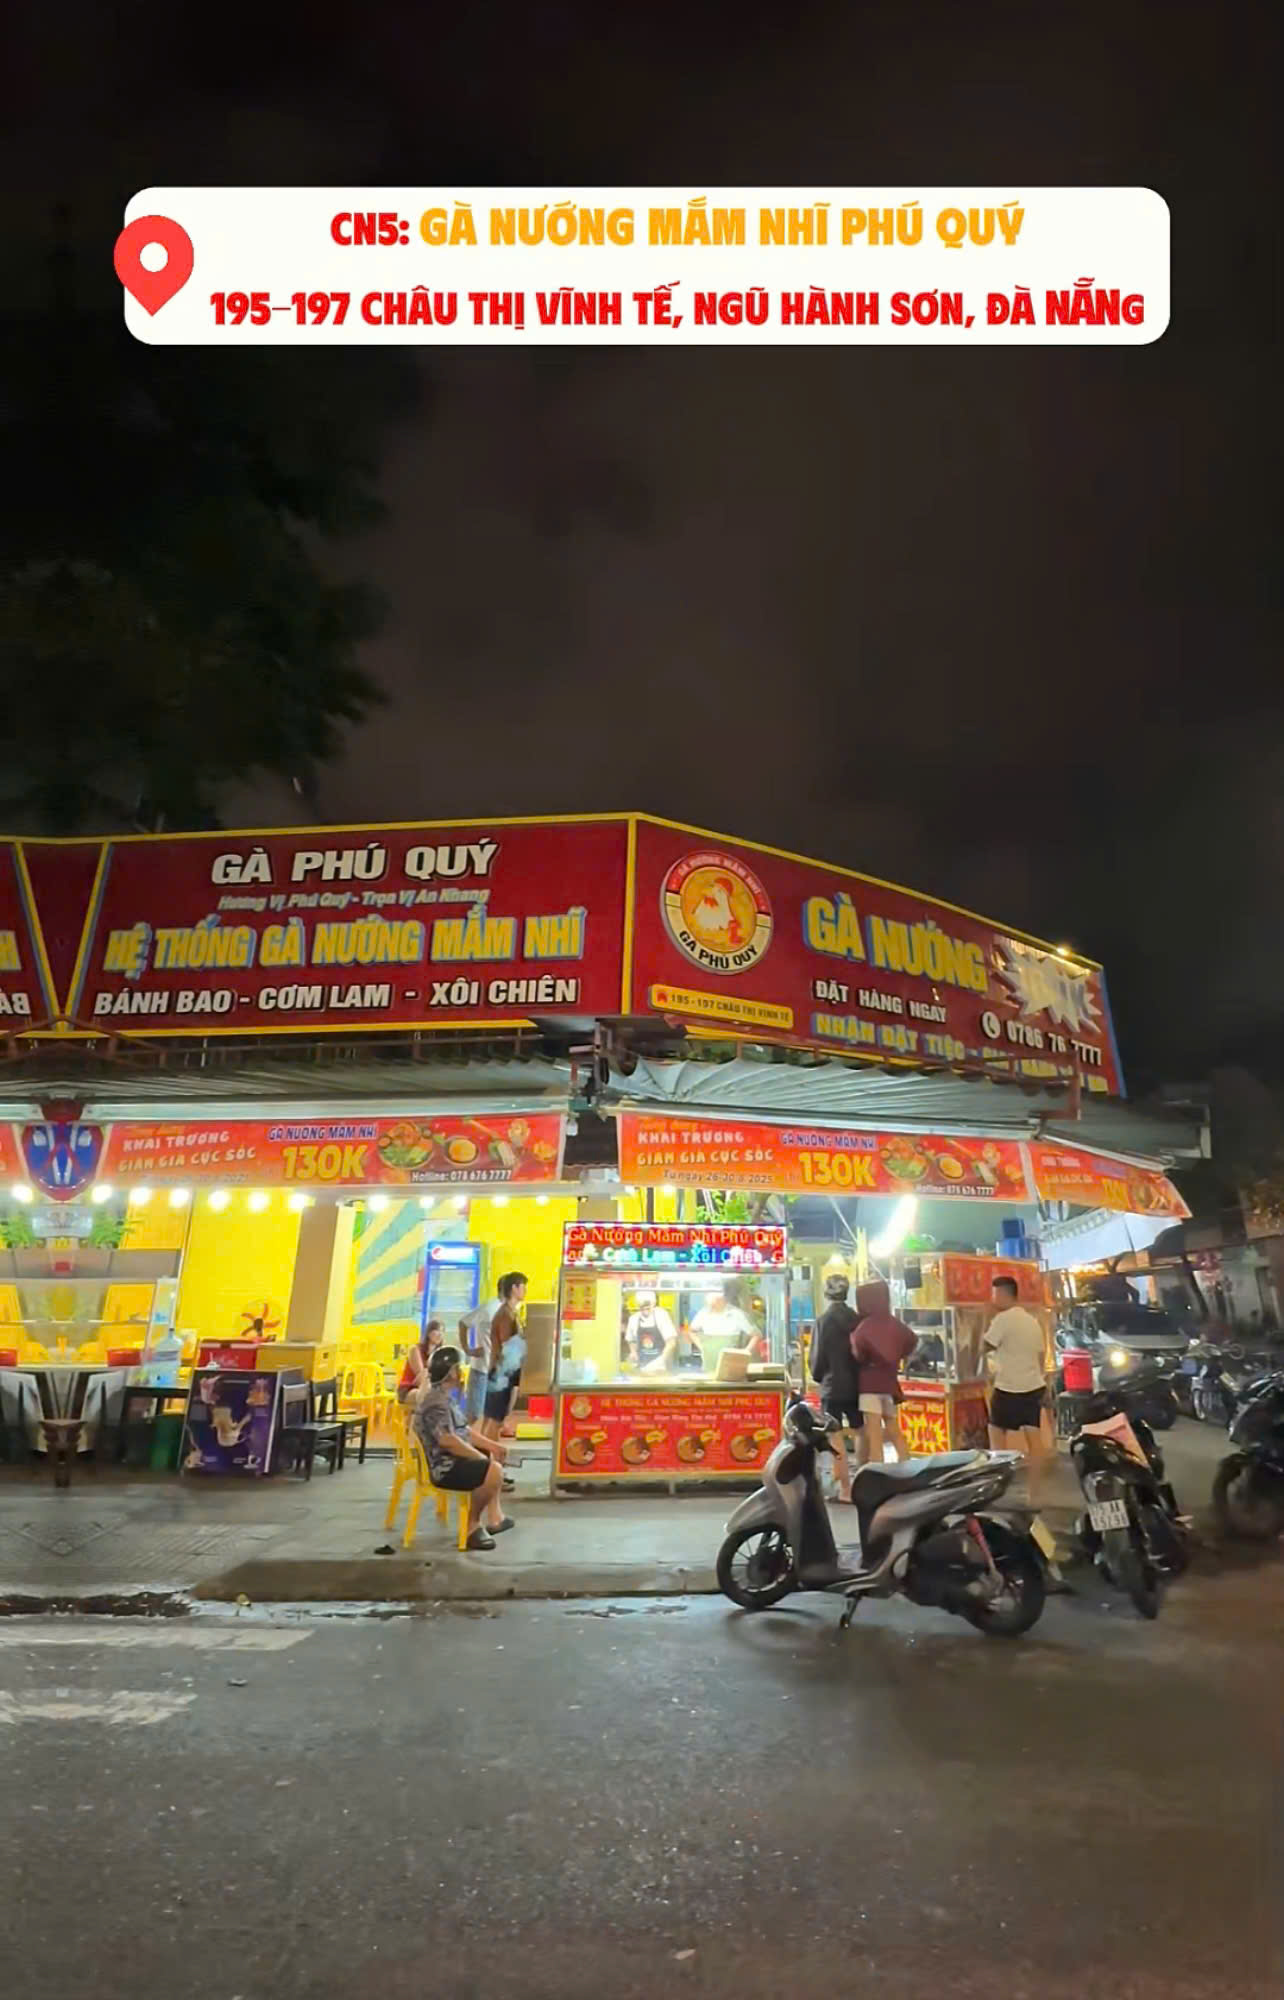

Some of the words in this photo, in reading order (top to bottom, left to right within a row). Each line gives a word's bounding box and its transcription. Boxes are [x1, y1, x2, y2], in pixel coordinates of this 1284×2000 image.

[211, 848, 272, 884] GÀ
[291, 843, 386, 882] PHÚ
[404, 838, 497, 880] QUÝ
[103, 922, 152, 980] HỆ
[154, 913, 257, 969] THỐNG
[259, 916, 305, 967] GÀ
[431, 903, 518, 962] MẮM
[803, 892, 866, 961] GÀ
[866, 915, 988, 992] NƯỚNG
[94, 988, 169, 1015] BÁNH
[176, 990, 232, 1013] BAO
[258, 983, 322, 1011] CƠM
[329, 984, 391, 1009] LAM
[429, 976, 480, 1005] XÔI
[488, 974, 577, 1004] CHIÊN
[815, 979, 849, 1004] ĐẶT
[858, 988, 903, 1014] HÀNG
[909, 1000, 946, 1022] NGAY
[812, 1012, 876, 1045] NHẬN
[1006, 1020, 1044, 1049] 0786
[1048, 1032, 1066, 1053] 76
[123, 1138, 160, 1152] KHAI
[637, 1131, 676, 1145] KHAI
[282, 1144, 369, 1179] 130K
[798, 1151, 877, 1188] 130K
[567, 1228, 587, 1241] Gà
